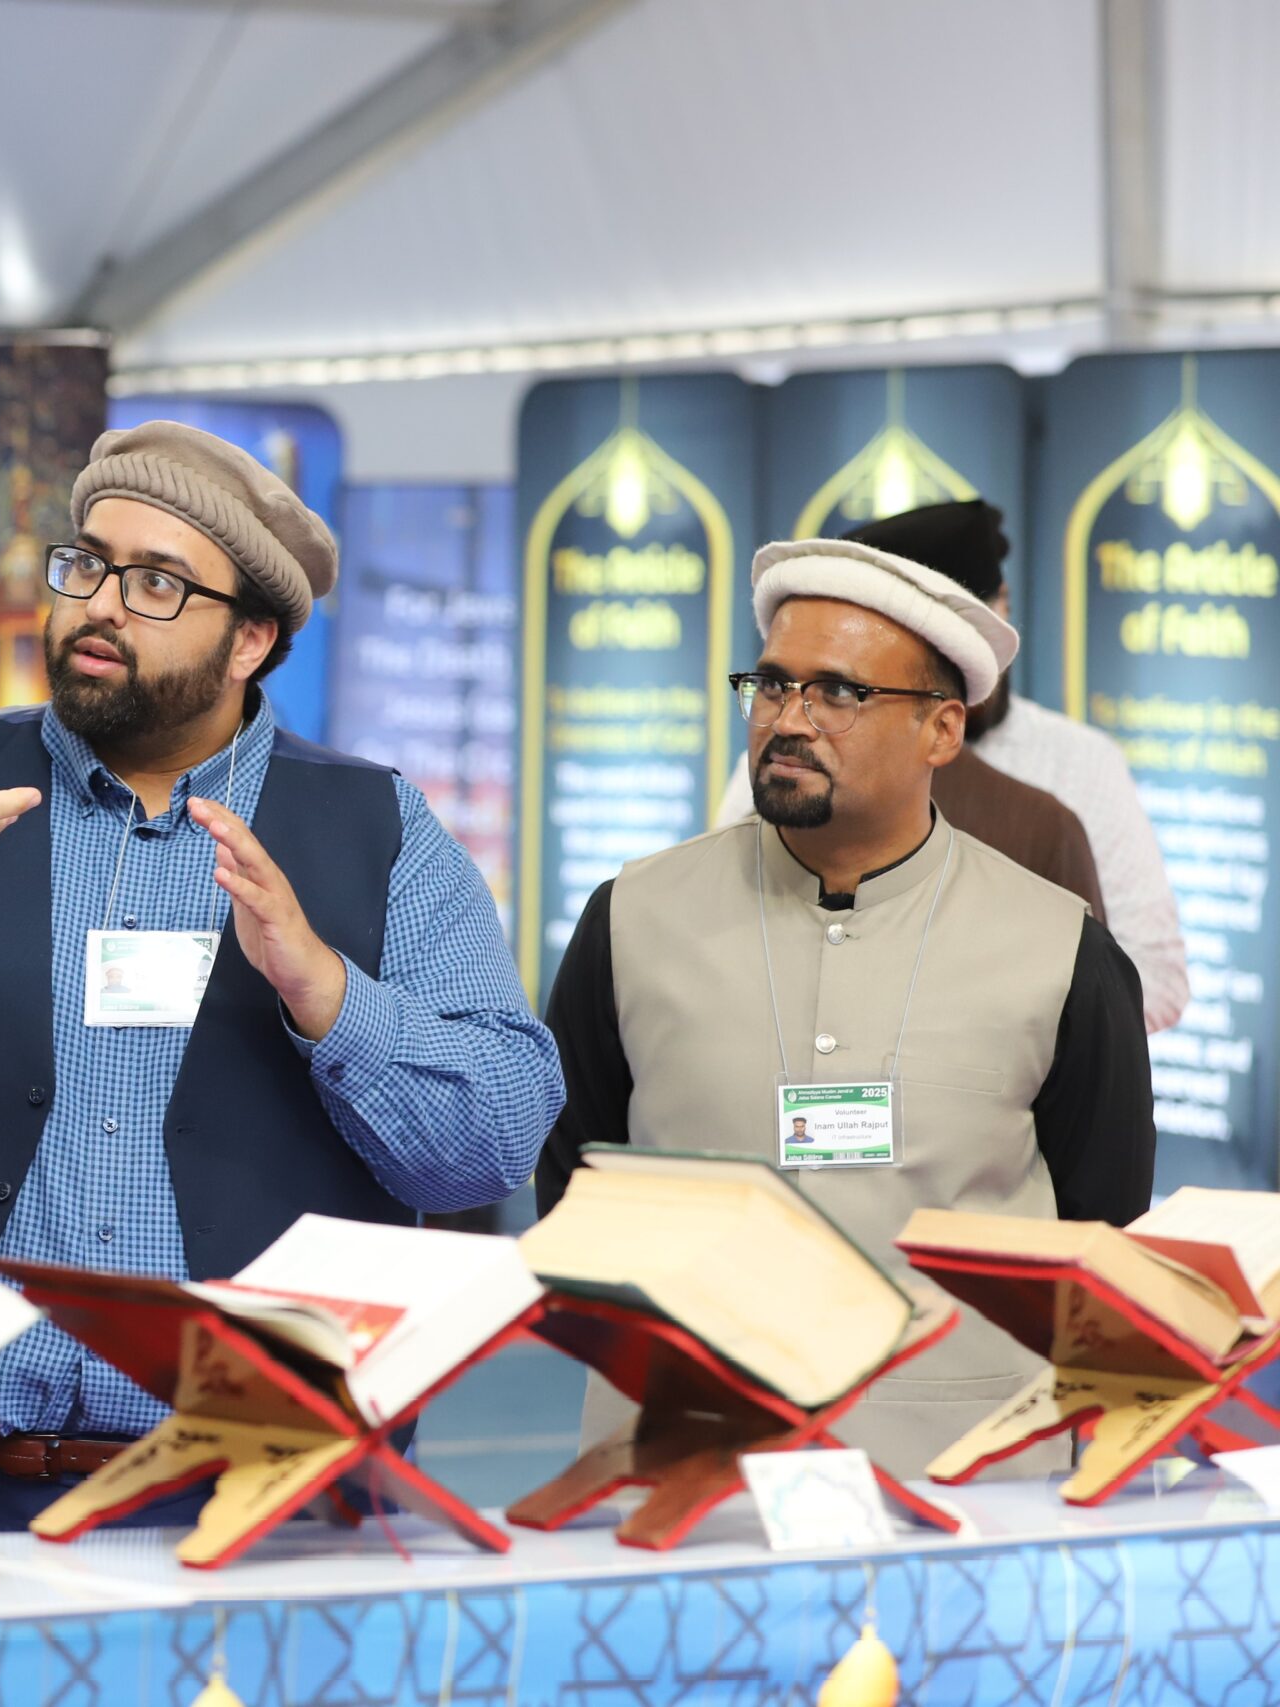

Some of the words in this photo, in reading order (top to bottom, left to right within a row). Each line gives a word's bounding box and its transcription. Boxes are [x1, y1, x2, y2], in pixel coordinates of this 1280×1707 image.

[1096, 540, 1162, 593] The
[1164, 540, 1279, 598] Article
[1120, 602, 1161, 655] of
[1162, 602, 1250, 659] Faith
[861, 1087, 888, 1098] 2025
[814, 1122, 835, 1130] Inam
[837, 1121, 858, 1129] Ullah
[861, 1120, 888, 1131] Rajput
